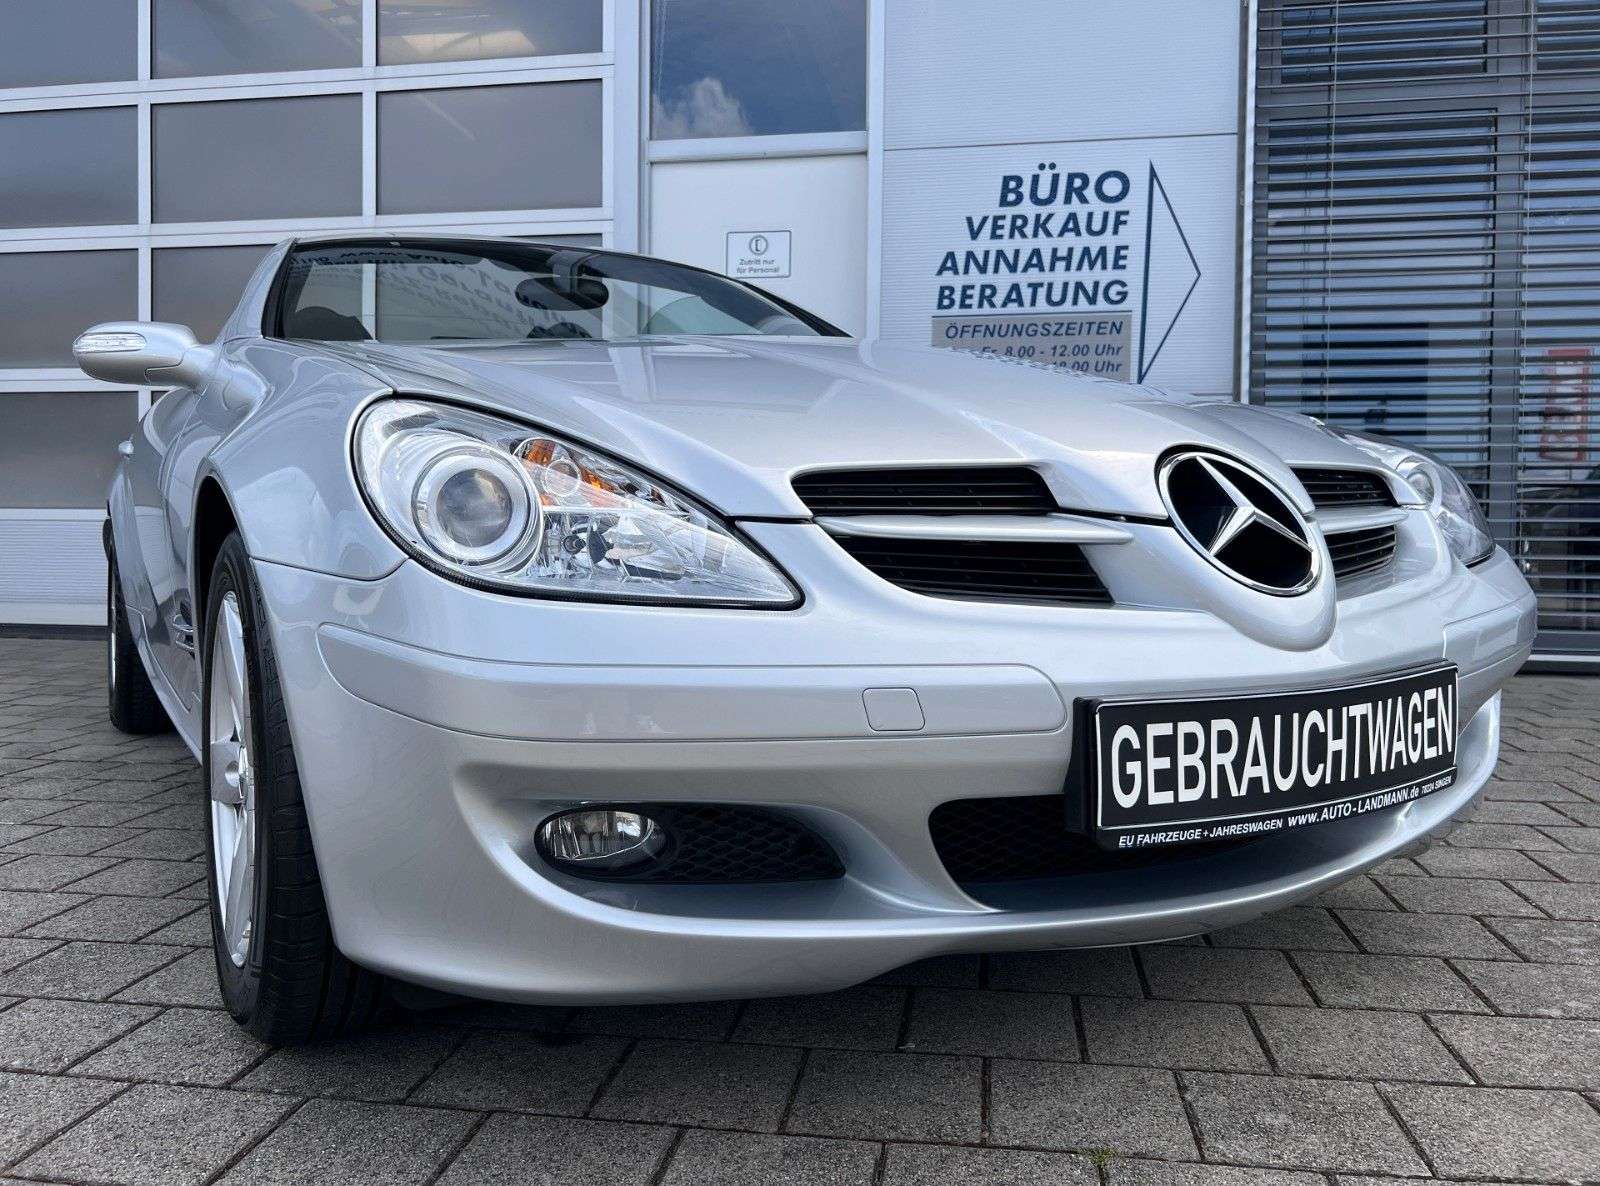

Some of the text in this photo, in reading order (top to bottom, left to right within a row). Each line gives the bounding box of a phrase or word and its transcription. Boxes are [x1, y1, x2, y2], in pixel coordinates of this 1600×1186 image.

[999, 162, 1130, 207] BÜRO
[965, 210, 1129, 240] VERKAUF
[739, 258, 760, 266] Zutritt
[748, 265, 780, 273] Personal
[936, 245, 1129, 276] ANNAHME
[937, 280, 1129, 311] BERATUNG
[945, 320, 1123, 339] ÖFFNUNGSZEITEN
[1051, 344, 1092, 357] 12.00
[1095, 343, 1123, 357] Uhr
[1095, 360, 1123, 373] Uhr
[1111, 684, 1453, 808] GEBRAUCHTWAGEN
[1118, 834, 1135, 847] EU
[1136, 828, 1202, 845] FAHRZEUGE
[1209, 818, 1283, 838] JAHRESWAGEN
